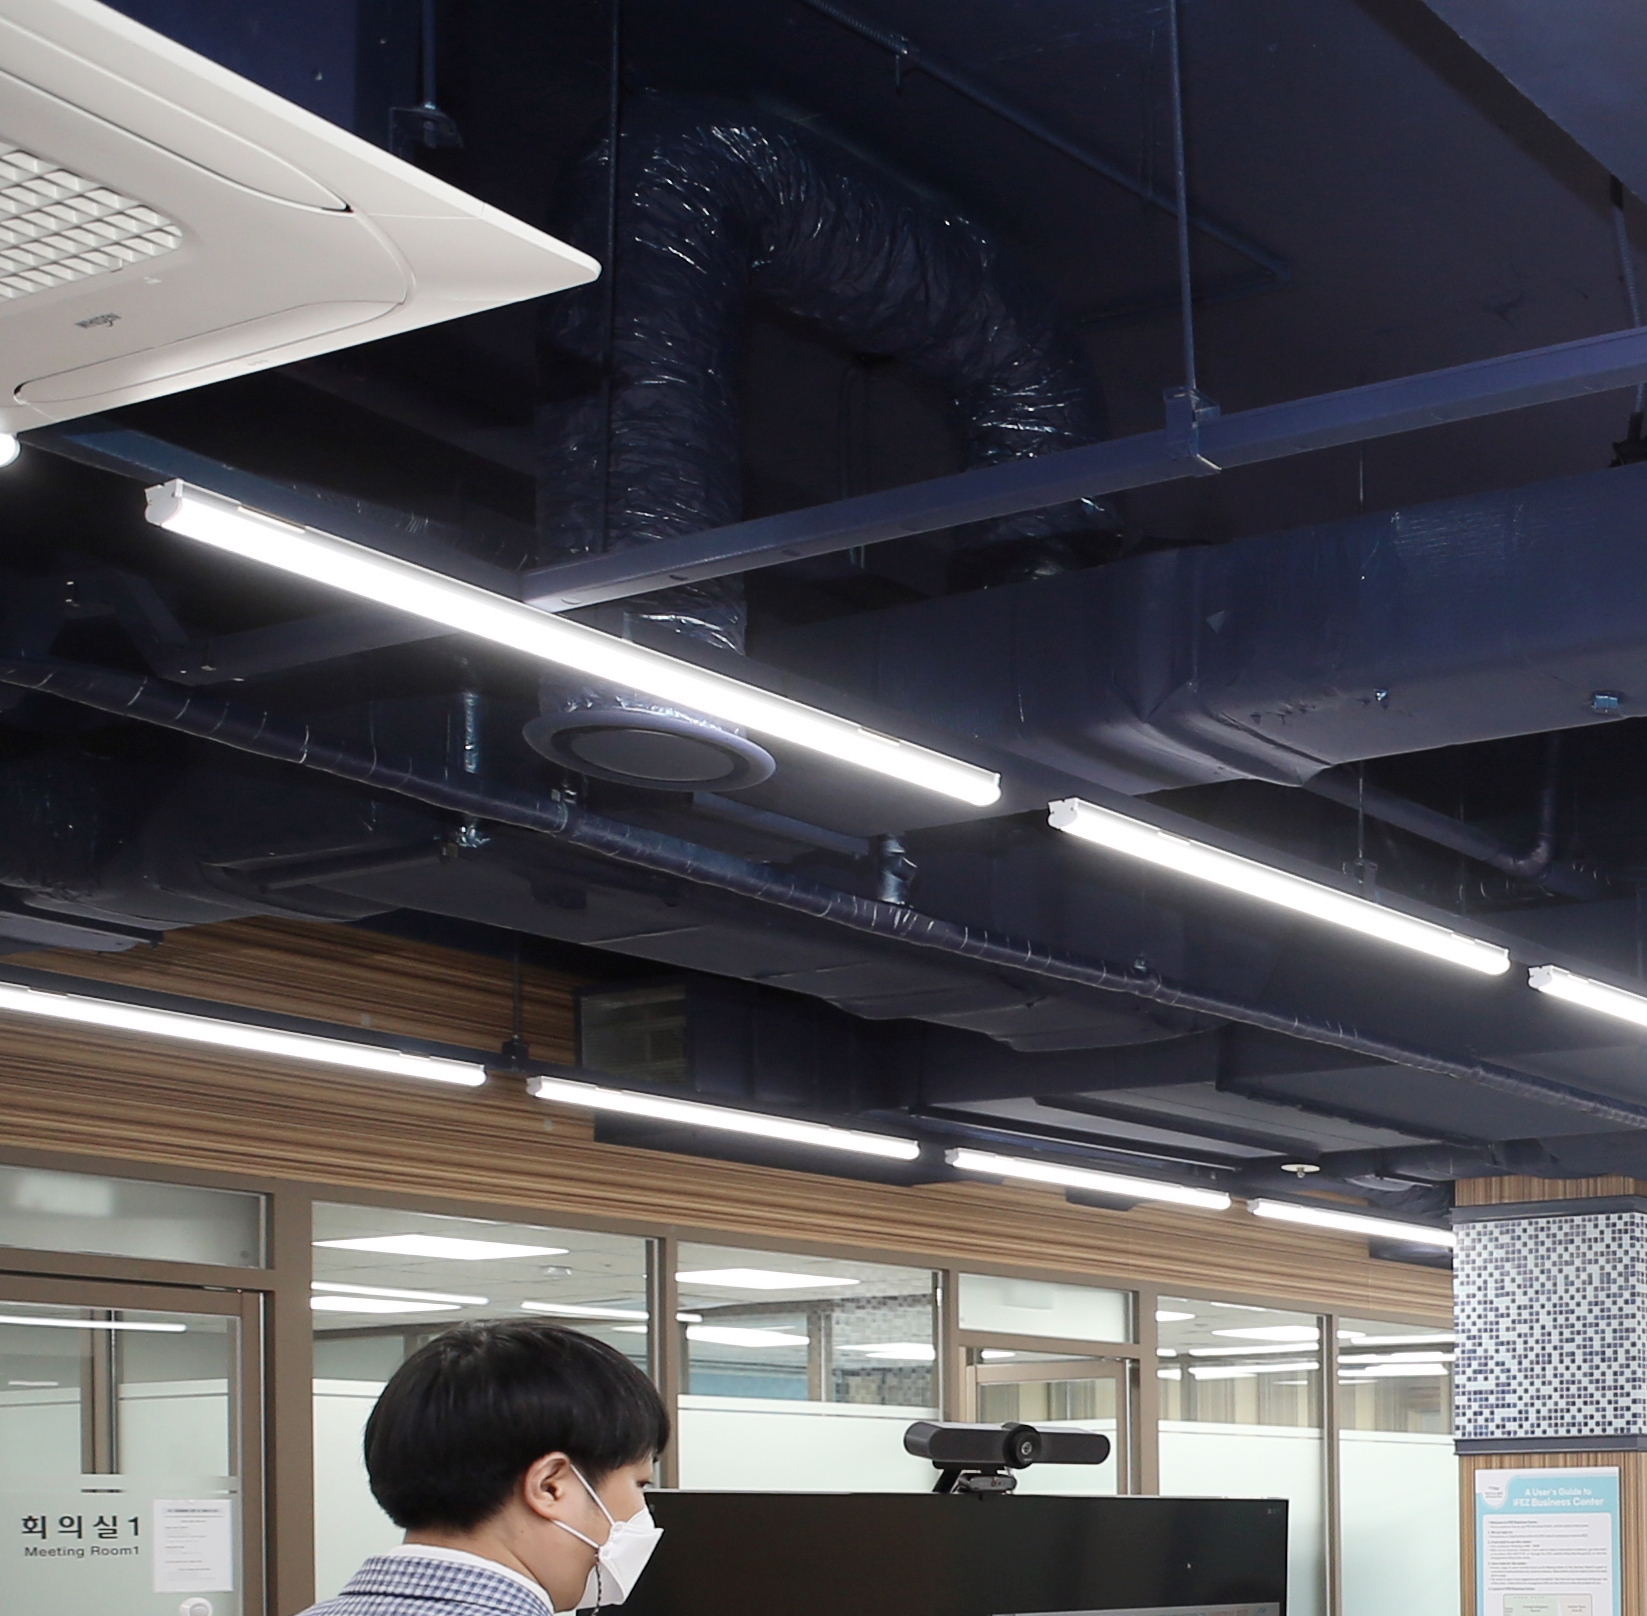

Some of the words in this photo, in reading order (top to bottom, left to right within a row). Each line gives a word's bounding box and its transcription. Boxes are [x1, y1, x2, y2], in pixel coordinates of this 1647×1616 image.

[1532, 1488, 1557, 1496] User's
[1559, 1487, 1579, 1496] Guide
[1580, 1487, 1592, 1495] to
[1531, 1498, 1571, 1507] Business
[1573, 1496, 1604, 1506] Center
[24, 1546, 85, 1558] Meeting
[90, 1545, 139, 1556] Room1
